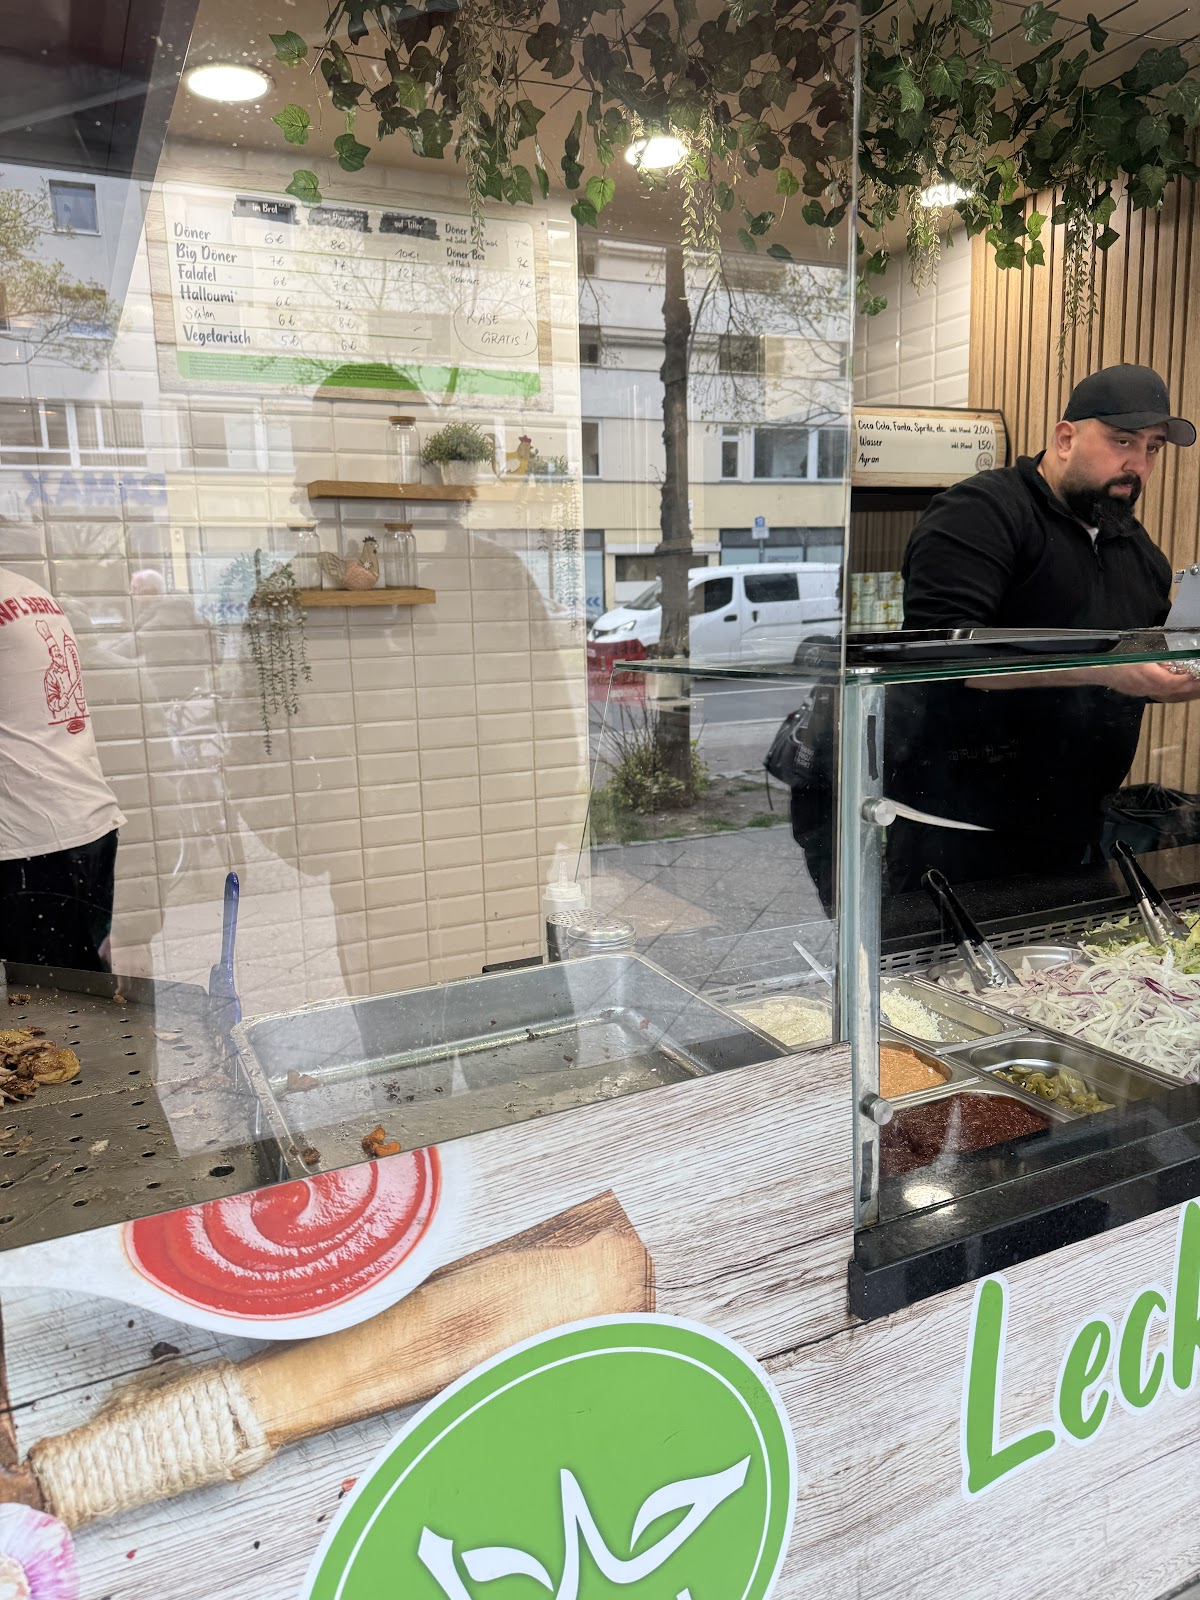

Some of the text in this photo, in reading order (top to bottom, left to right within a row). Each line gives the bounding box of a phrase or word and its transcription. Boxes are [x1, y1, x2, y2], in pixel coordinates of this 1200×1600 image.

[174, 221, 212, 241] Döner
[470, 225, 484, 237] Bx
[176, 242, 197, 265] Big
[201, 245, 238, 264] Döner
[178, 263, 217, 282] Falafel
[180, 284, 234, 303] Halloumi
[182, 324, 251, 347] Vegetarisch
[859, 436, 883, 447] Wasser
[858, 452, 880, 467] Ayran
